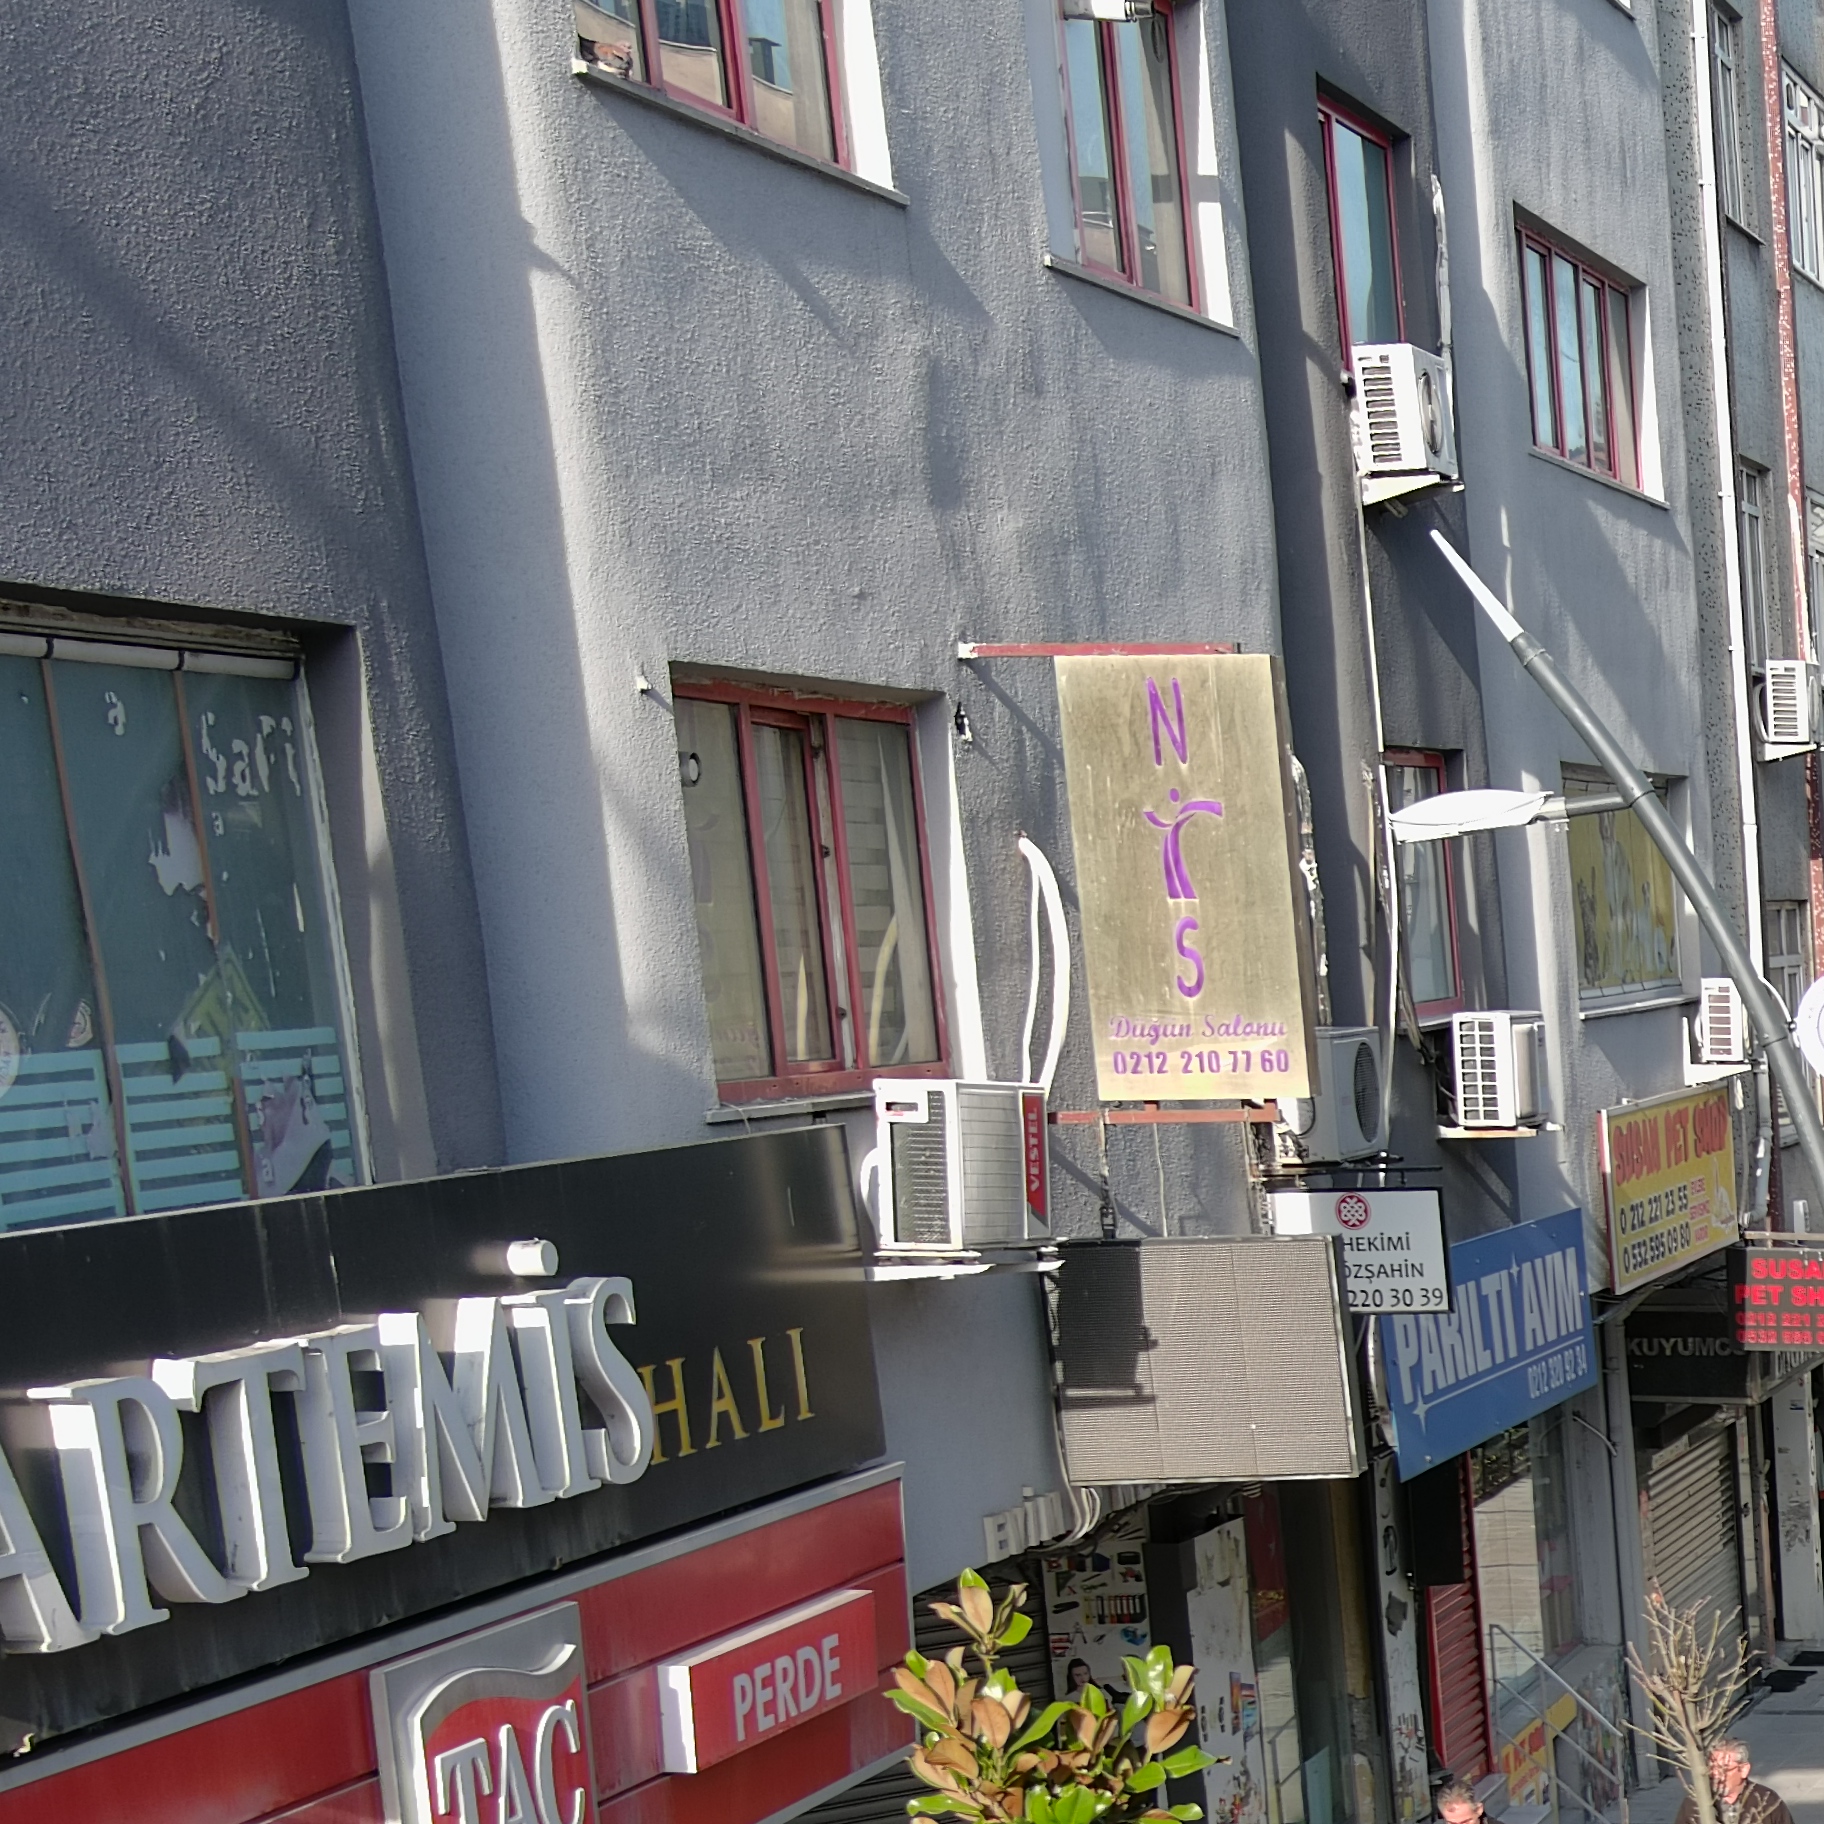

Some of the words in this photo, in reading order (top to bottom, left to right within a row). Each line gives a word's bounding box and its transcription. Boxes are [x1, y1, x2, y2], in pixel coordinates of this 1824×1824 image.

[1108, 1015, 1192, 1045] Düğün
[1201, 1013, 1288, 1040] Salonu
[1113, 1050, 1169, 1075] 0212
[1180, 1049, 1222, 1075] 210
[1229, 1050, 1252, 1074] 77
[1260, 1049, 1290, 1074] 60
[1025, 1104, 1041, 1193] VESTEL
[1612, 1113, 1661, 1187] SUSAN
[1664, 1105, 1690, 1169] PET
[1619, 1206, 1627, 1235] 0
[1629, 1200, 1646, 1232] 212
[1647, 1193, 1663, 1225] 221
[1343, 1231, 1412, 1252] HEKİMİ
[1623, 1246, 1631, 1274] 0
[1347, 1288, 1384, 1308] 220
[1389, 1288, 1414, 1308] 30
[1419, 1287, 1444, 1307] 39
[1734, 1283, 1785, 1306] PET
[1392, 1268, 1518, 1406] PARILTI
[1521, 1246, 1584, 1352] AVM
[648, 1327, 816, 1466] HALI
[731, 1632, 843, 1742] PERDE
